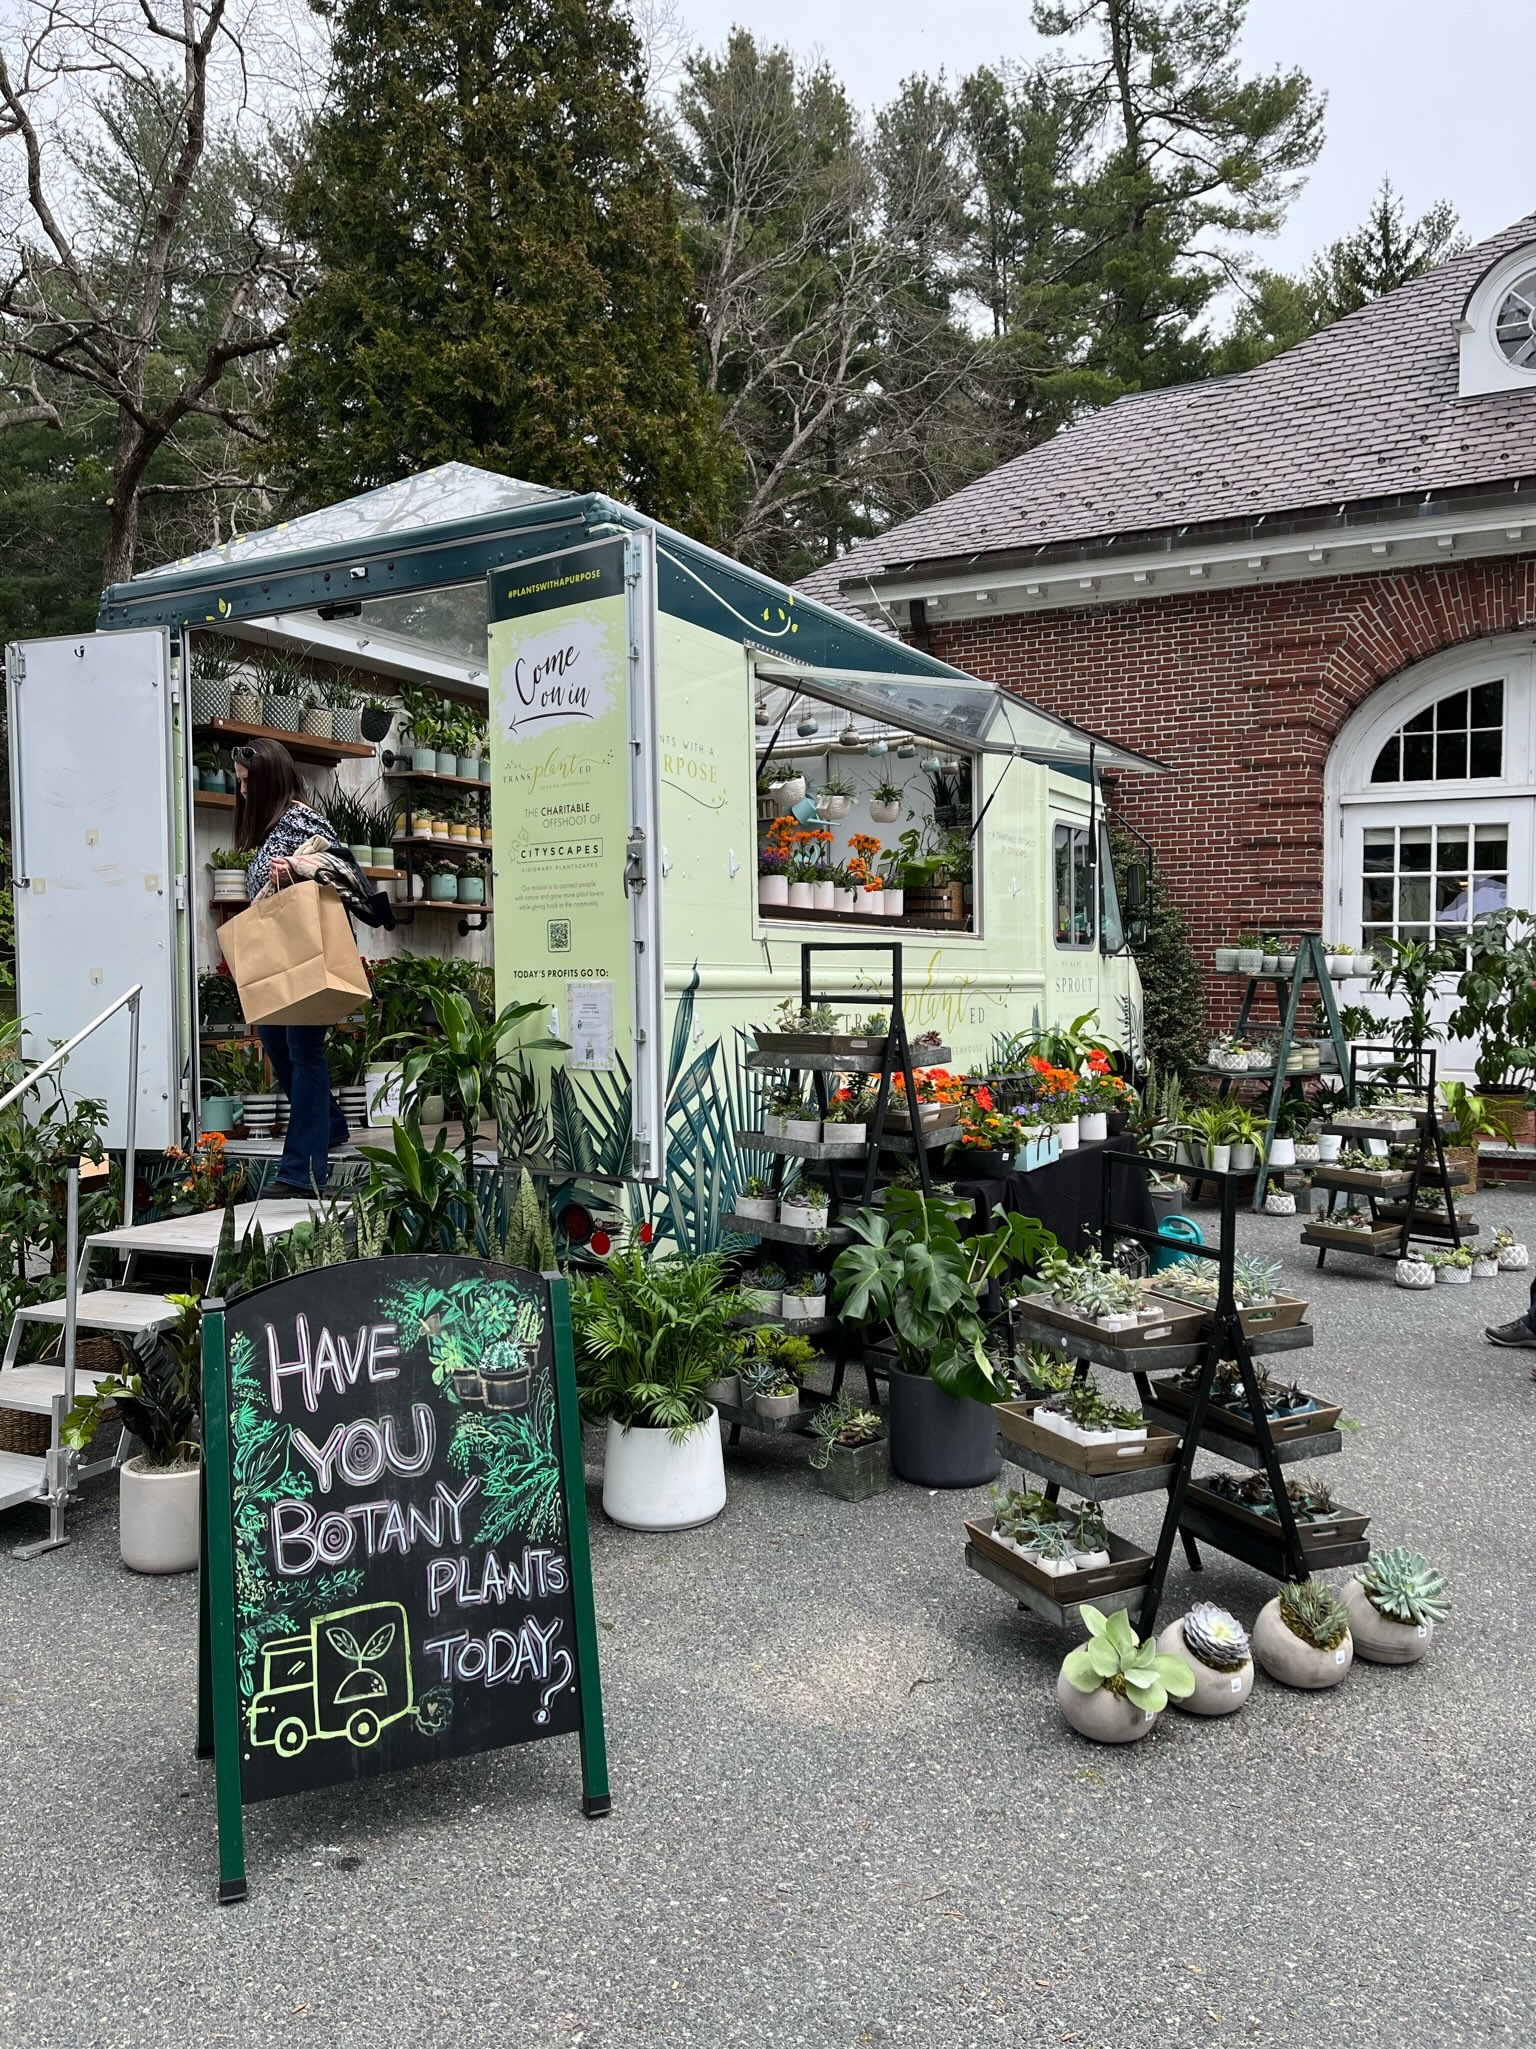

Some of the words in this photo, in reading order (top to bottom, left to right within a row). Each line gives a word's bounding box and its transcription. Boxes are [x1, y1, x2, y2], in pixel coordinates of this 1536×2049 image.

[508, 570, 601, 599] #PLANTSWITHAPURPOSE
[515, 645, 580, 706] Come
[541, 685, 566, 708] on
[568, 683, 590, 708] in
[683, 741, 704, 754] WITH
[709, 747, 714, 757] A
[664, 753, 717, 784] RPOSE
[525, 808, 538, 818] THE
[541, 803, 590, 816] CHARITABLE
[543, 815, 587, 828] OFFSHOOT
[590, 814, 601, 824] OF
[521, 845, 599, 858] CITYSCAPES
[556, 862, 598, 871] PLANTSCAPES
[513, 970, 546, 978] TODAY'S
[548, 969, 578, 978] PROFITS
[581, 969, 593, 977] GO
[596, 969, 609, 977] TO:
[1056, 977, 1093, 993] SPROUT
[265, 1312, 400, 1413] HAVE
[291, 1403, 437, 1493] YOU
[271, 1475, 483, 1576] BOTANY
[426, 1547, 569, 1617] PLANTS
[423, 1615, 576, 1725] TODAY?
